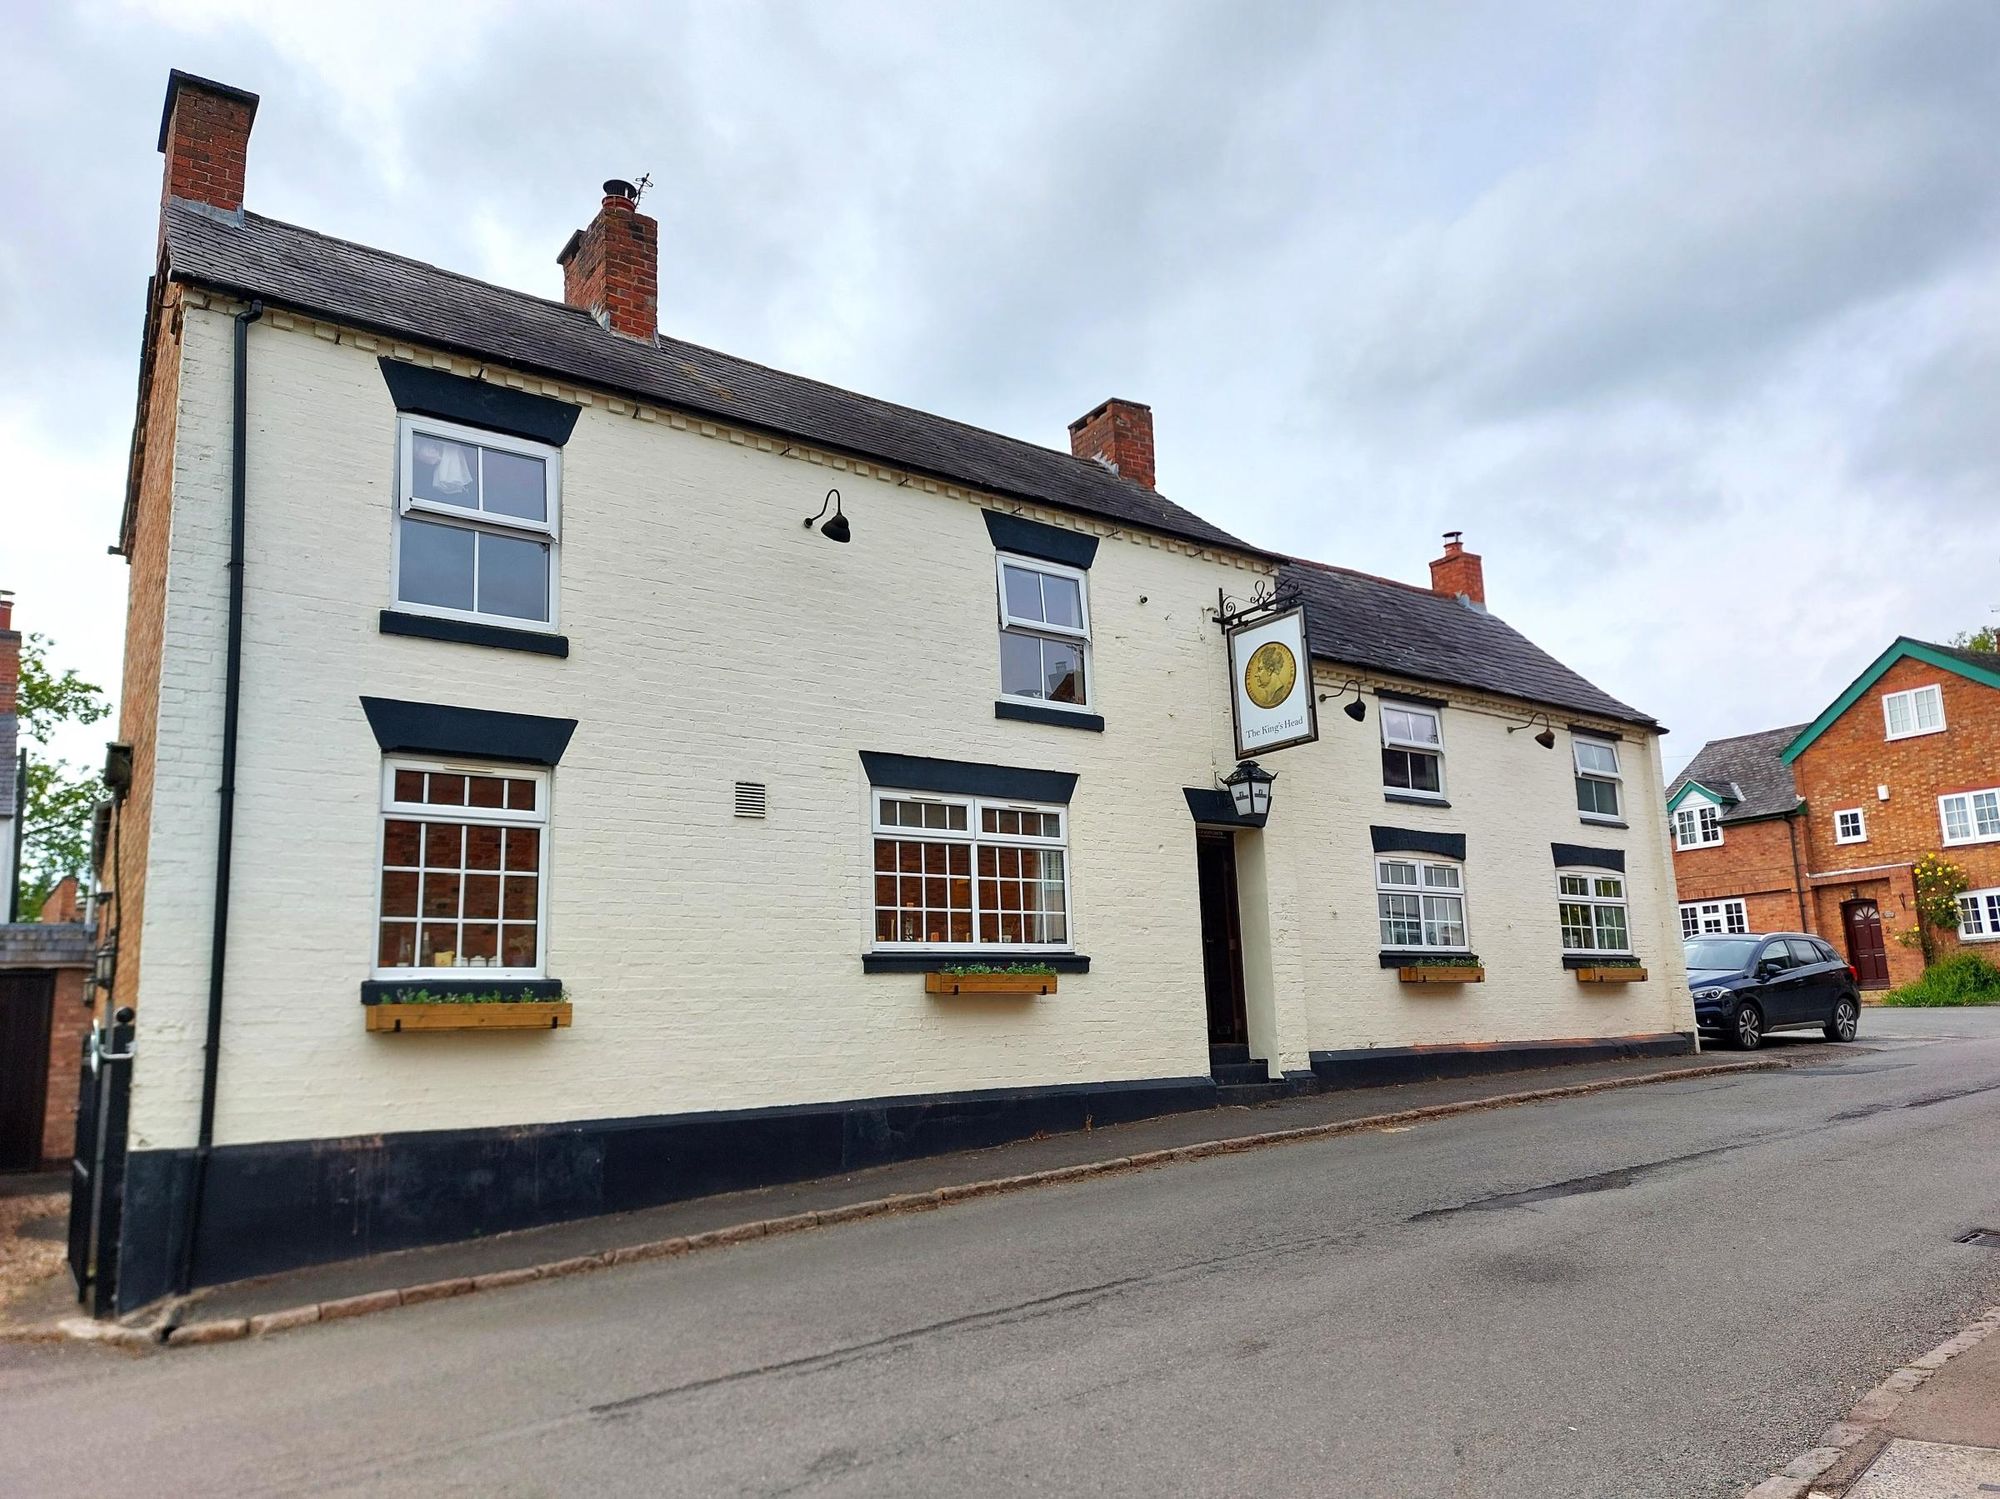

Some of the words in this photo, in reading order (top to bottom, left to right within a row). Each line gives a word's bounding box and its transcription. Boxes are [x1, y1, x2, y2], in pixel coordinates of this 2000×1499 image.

[1246, 729, 1261, 738] The
[1262, 721, 1284, 734] King's
[1284, 715, 1303, 729] Head
